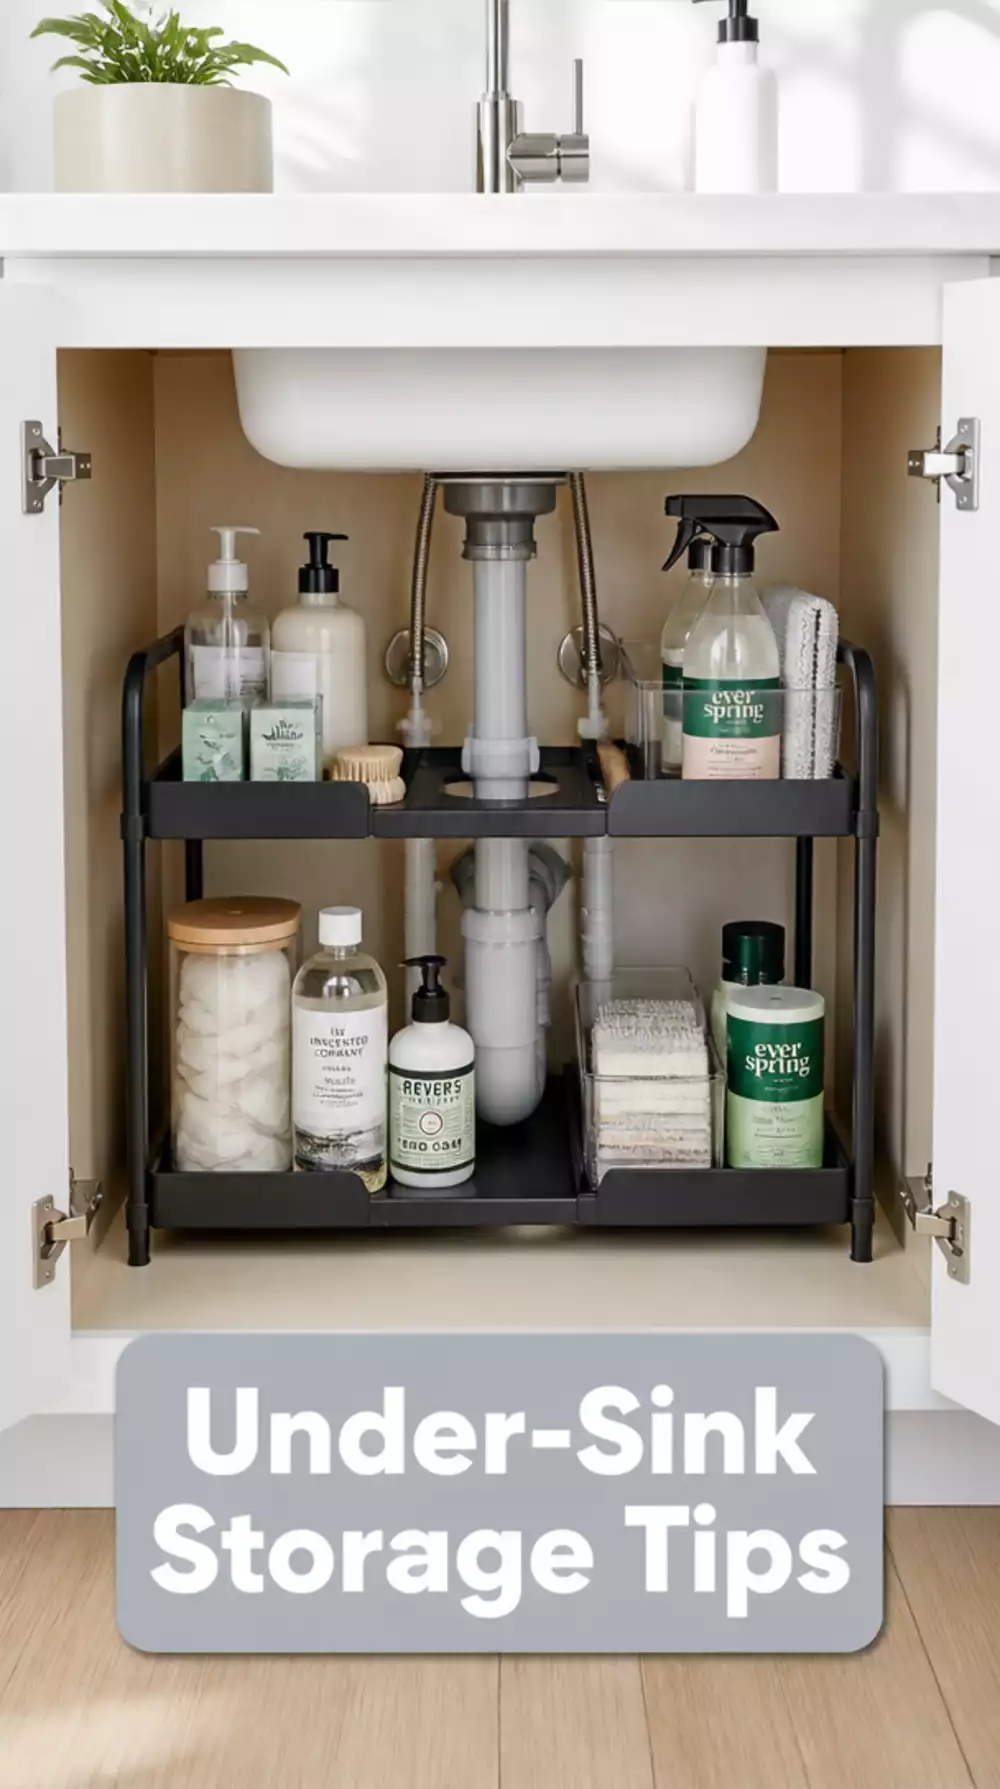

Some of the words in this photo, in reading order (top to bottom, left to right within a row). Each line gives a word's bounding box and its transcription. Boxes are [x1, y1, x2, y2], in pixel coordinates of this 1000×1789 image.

[711, 689, 756, 705] ever
[703, 703, 764, 724] spring
[754, 1042, 802, 1058] ever
[744, 1055, 811, 1078] spring
